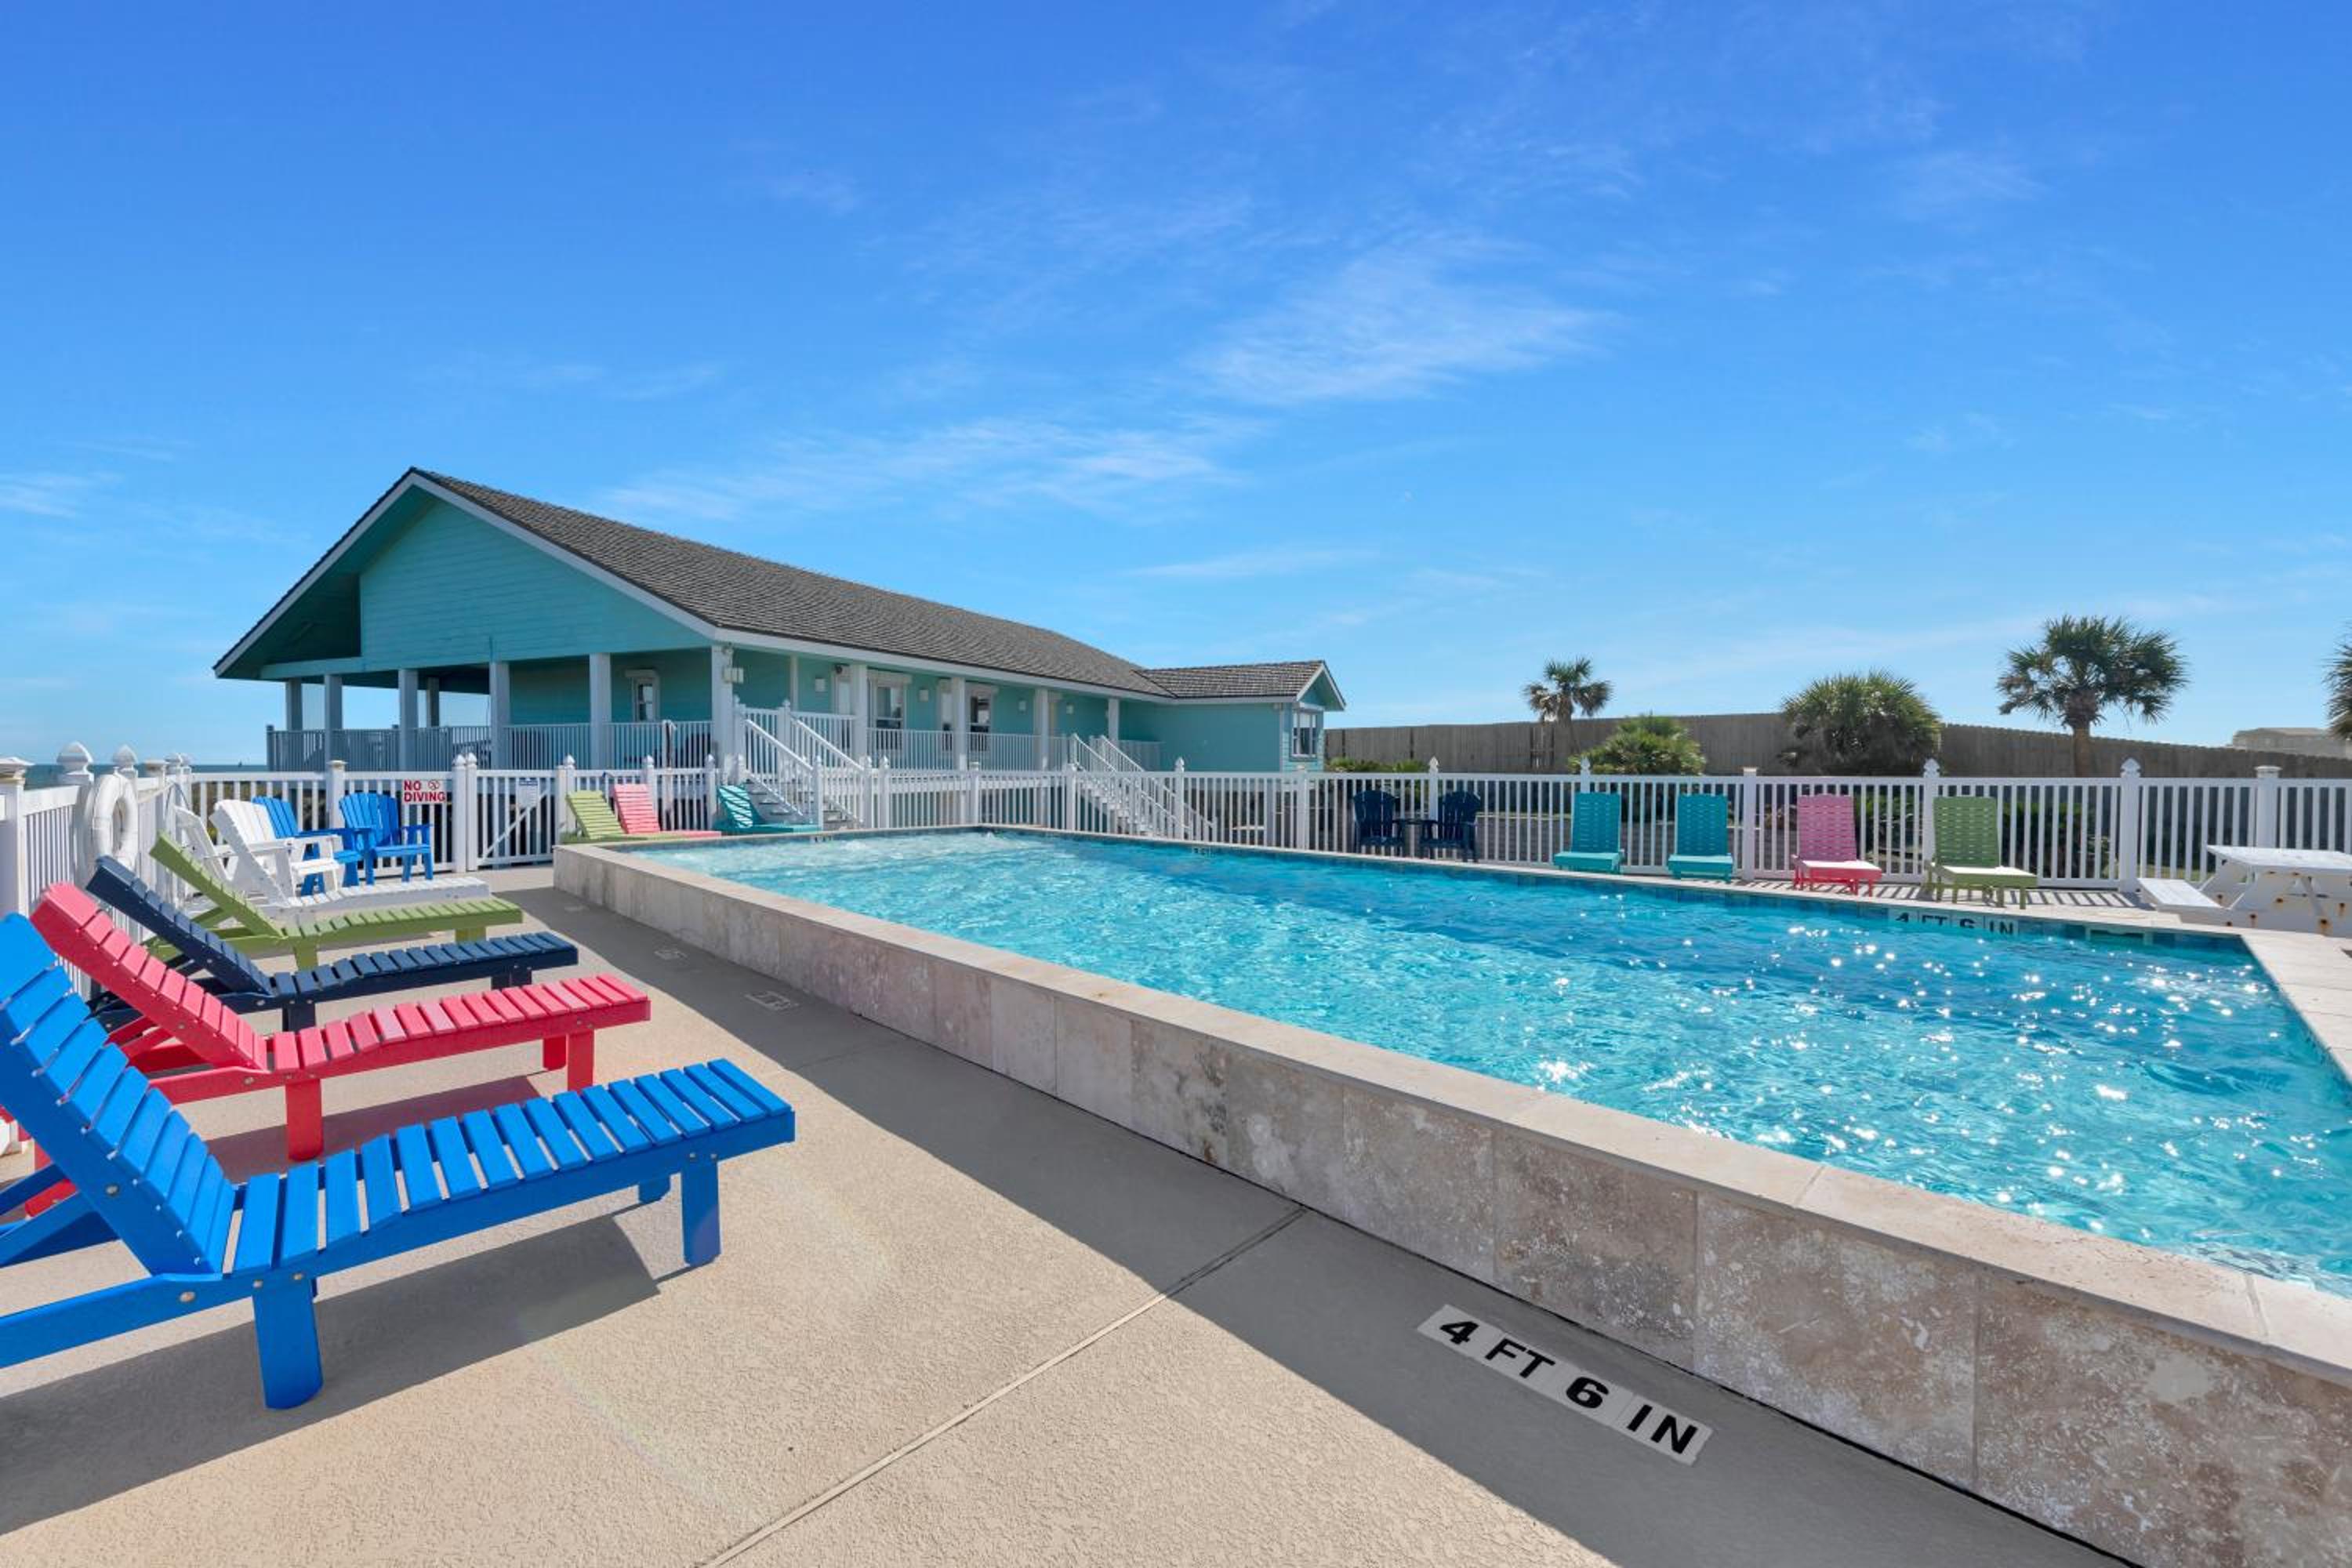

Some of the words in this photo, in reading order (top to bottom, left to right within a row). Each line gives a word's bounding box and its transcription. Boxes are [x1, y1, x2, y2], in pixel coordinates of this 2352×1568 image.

[404, 779, 421, 791] NO
[404, 792, 445, 802] DIVING
[1439, 1321, 1479, 1345] 4
[1485, 1338, 1555, 1378] FT
[1566, 1376, 1609, 1409] 6
[1627, 1404, 1697, 1454] IN
